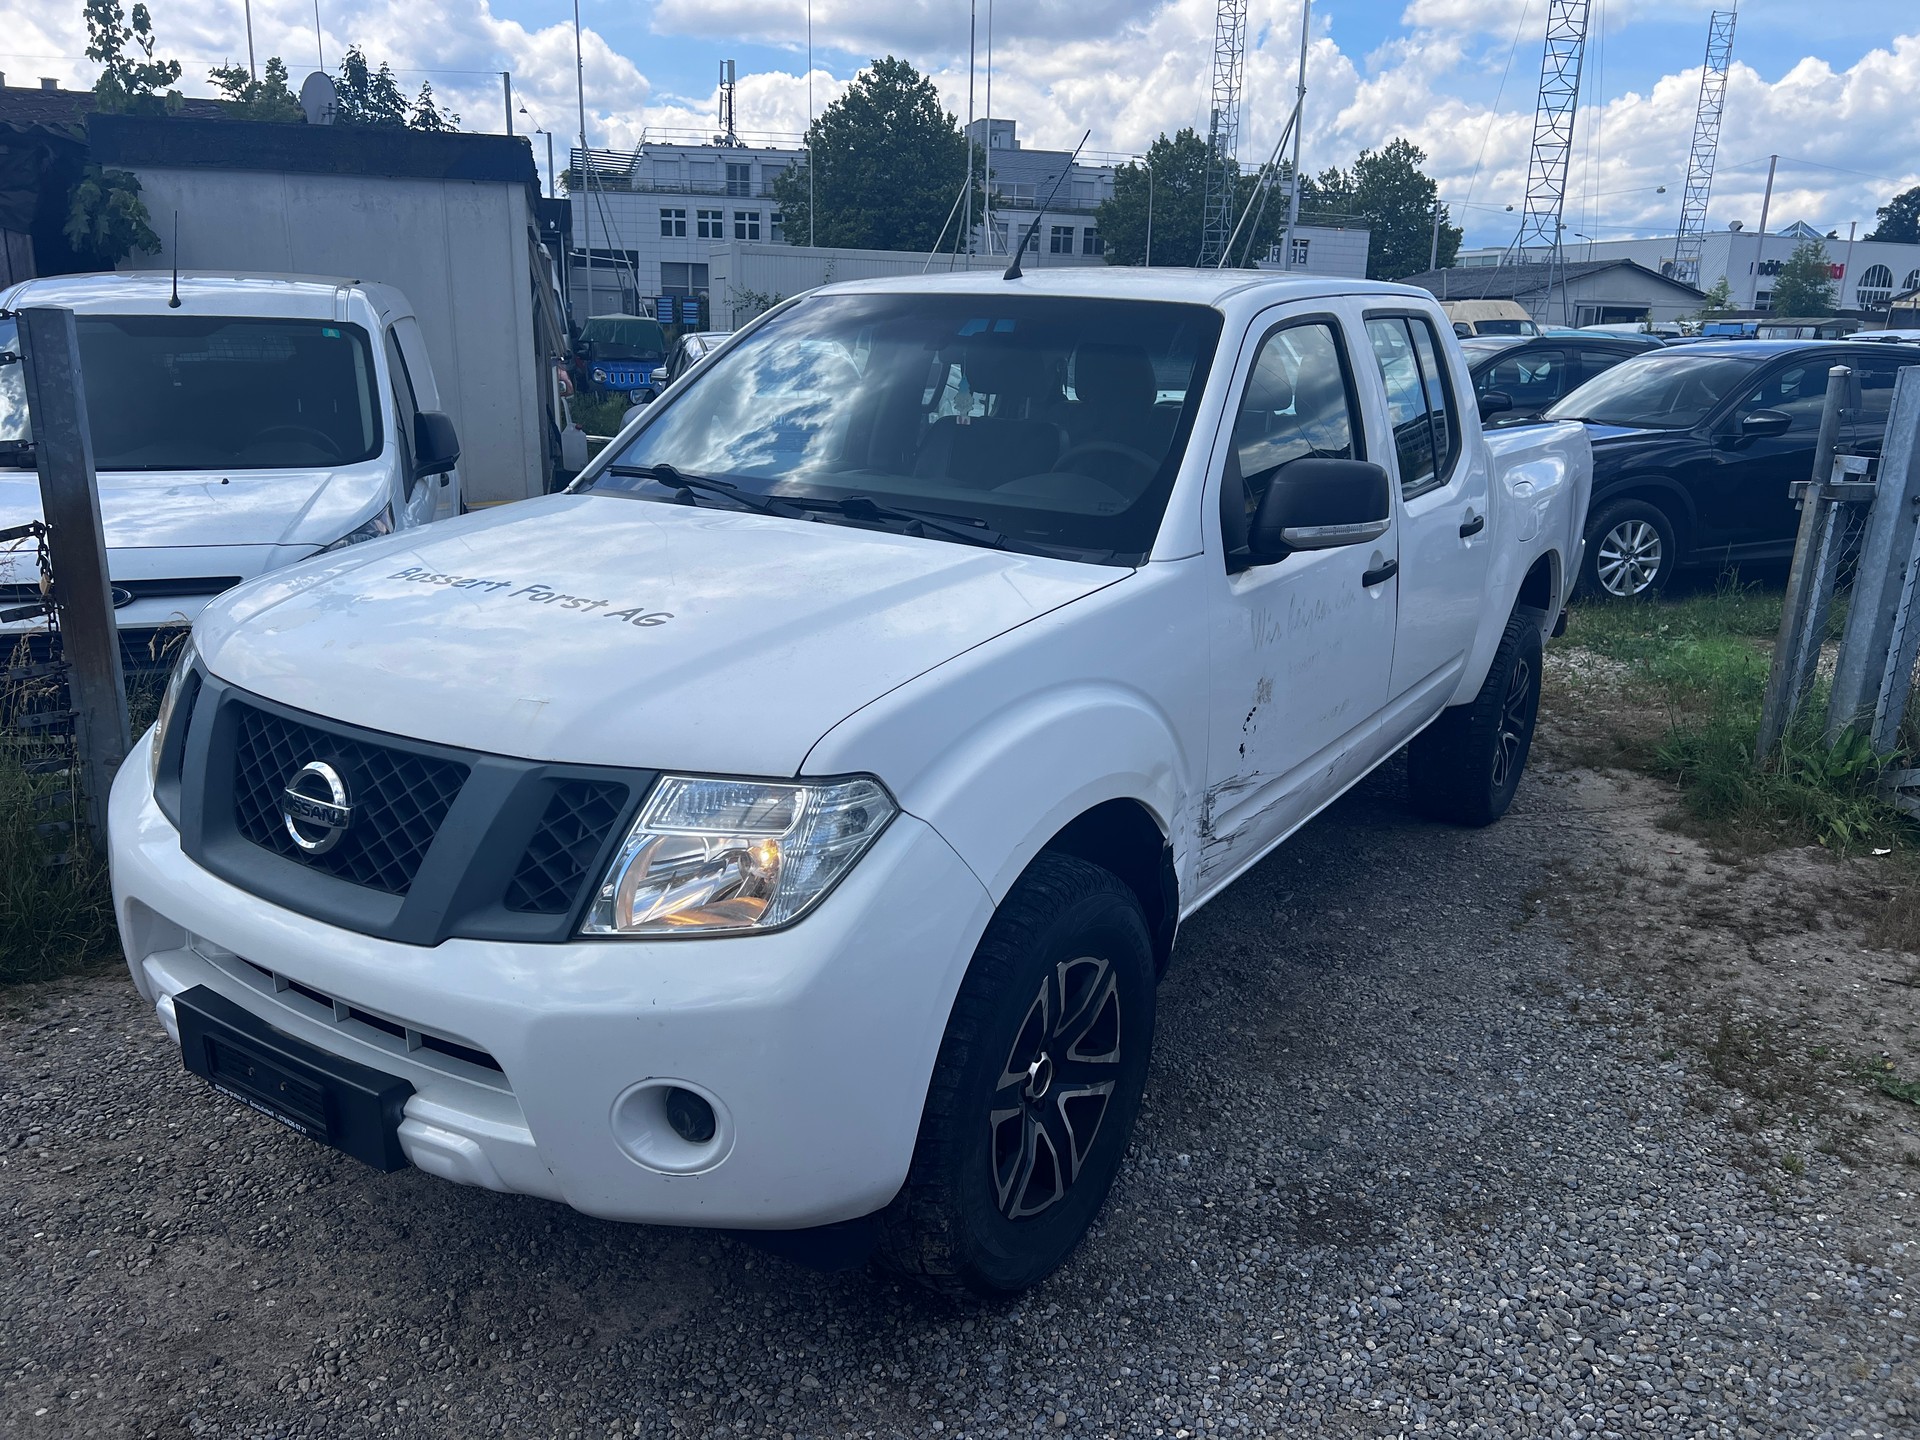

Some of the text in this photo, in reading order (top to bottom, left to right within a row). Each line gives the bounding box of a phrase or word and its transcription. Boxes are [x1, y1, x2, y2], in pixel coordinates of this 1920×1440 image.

[386, 567, 675, 627] Bossert Forst AG
